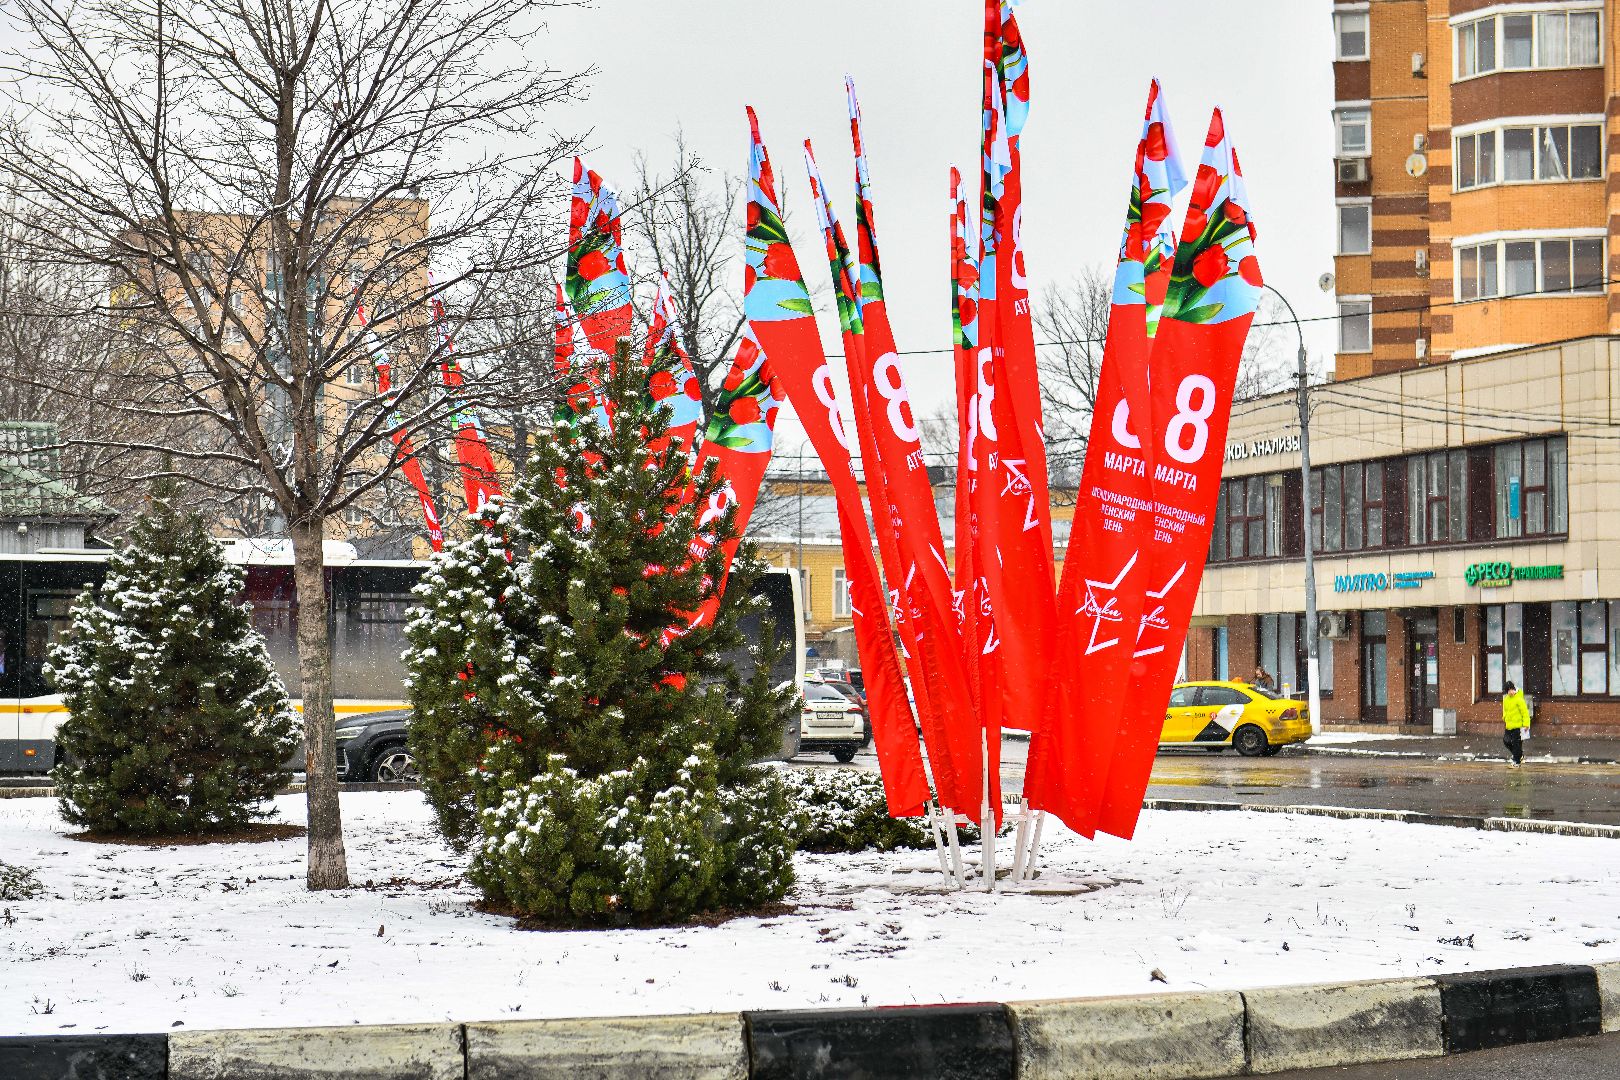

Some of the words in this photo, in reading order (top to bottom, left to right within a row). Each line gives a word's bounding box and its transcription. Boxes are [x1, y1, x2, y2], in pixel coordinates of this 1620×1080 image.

[873, 352, 919, 442] 8
[1165, 374, 1216, 463] 8
[1251, 435, 1300, 457] АНАЛИЗЫ
[1104, 452, 1146, 477] МАРТА
[1154, 464, 1197, 491] МАРТА
[1334, 572, 1387, 592] INVITRO
[1479, 562, 1512, 580] РЕСО
[1513, 565, 1564, 581] СТРАХОВАНИЕ
